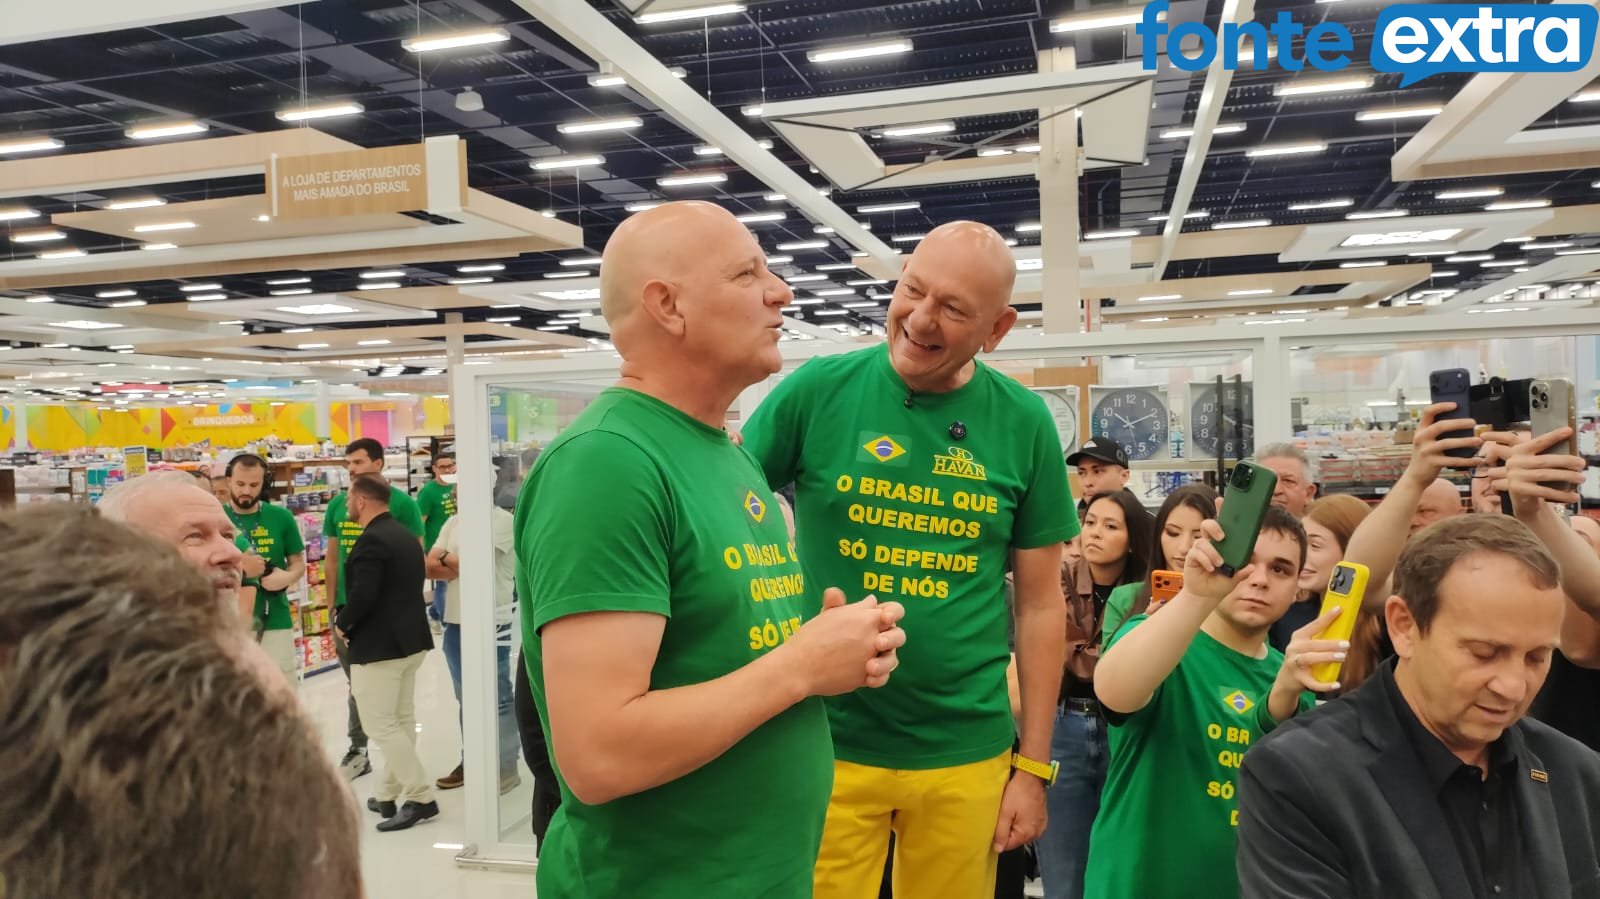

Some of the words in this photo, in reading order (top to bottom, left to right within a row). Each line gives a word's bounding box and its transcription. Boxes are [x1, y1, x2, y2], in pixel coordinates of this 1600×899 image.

[282, 176, 290, 187] A
[291, 174, 316, 187] LOJA
[317, 171, 331, 184] DE
[333, 164, 421, 183] DEPARTAMENTOS
[294, 187, 318, 201] MAIS
[319, 184, 356, 199] AMADA
[356, 182, 372, 196] DO
[374, 179, 410, 194] BRASIL
[1114, 398, 1121, 407] 11
[1126, 394, 1136, 404] 12
[1103, 407, 1113, 416] 10
[1151, 408, 1158, 418] 2
[1203, 403, 1213, 413] 10
[1100, 419, 1108, 429] 9
[1200, 415, 1208, 425] 9
[1153, 421, 1160, 430] 3
[1148, 433, 1156, 442] 4
[1201, 428, 1209, 438] 8
[1138, 442, 1146, 452] 5
[1211, 437, 1218, 447] 7
[1225, 442, 1233, 452] 6
[1124, 445, 1132, 455] 6
[934, 457, 986, 478] HAVAN
[836, 475, 853, 492] O
[859, 476, 944, 506] BRASIL
[952, 491, 998, 514] QUE
[848, 504, 981, 538] QUEREMOS
[724, 546, 742, 570] O
[838, 539, 867, 560] SÓ
[874, 545, 978, 573] DEPENDE
[864, 572, 894, 593] DE
[901, 576, 949, 599] NÓS
[750, 618, 779, 650] SÓ
[1208, 723, 1222, 740] O
[1207, 780, 1234, 800] SÓ
